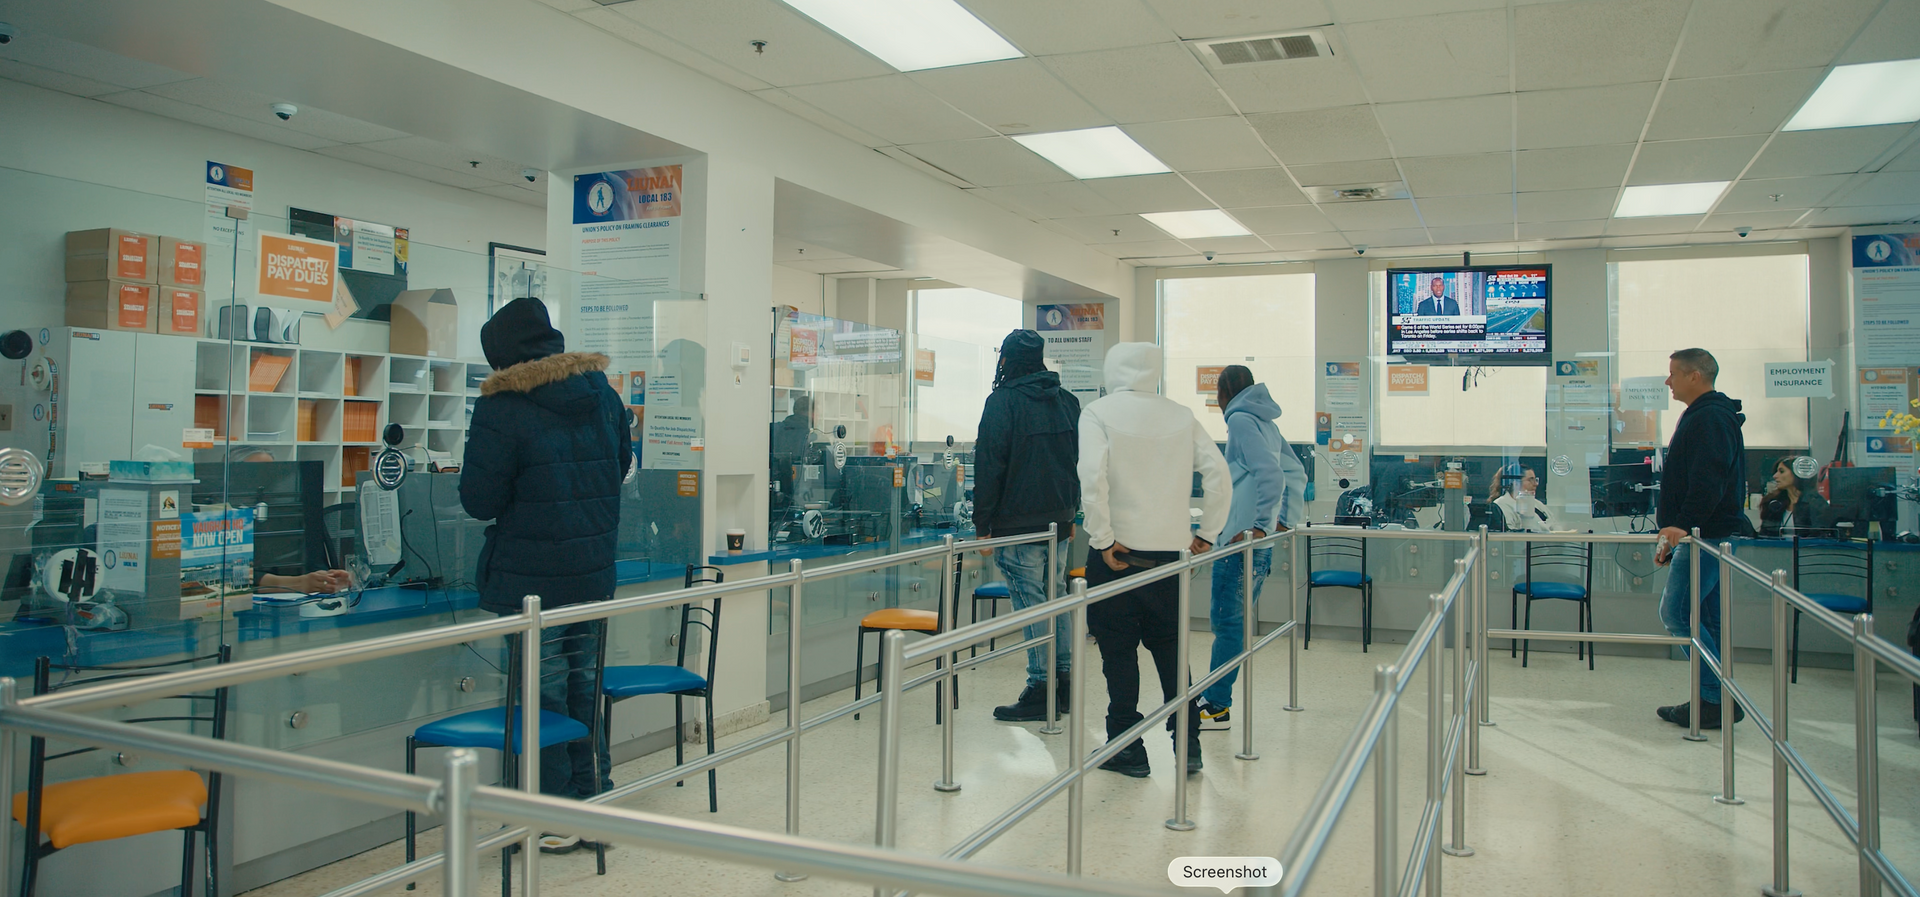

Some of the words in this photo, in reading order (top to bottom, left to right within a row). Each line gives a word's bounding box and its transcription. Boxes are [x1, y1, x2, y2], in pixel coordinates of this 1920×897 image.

[626, 174, 674, 191] LIUNA!
[638, 194, 658, 204] LOCAL
[660, 192, 672, 202] 183
[220, 227, 244, 235] EXCEPTNS
[622, 222, 642, 230] FRAMING
[268, 253, 328, 273] DISPATCH/
[267, 265, 293, 280] PAY
[294, 269, 328, 285] DUES
[192, 520, 230, 533] VAUGHAN
[232, 518, 244, 530] HQ
[193, 532, 216, 548] NOW
[218, 529, 243, 545] OPEN
